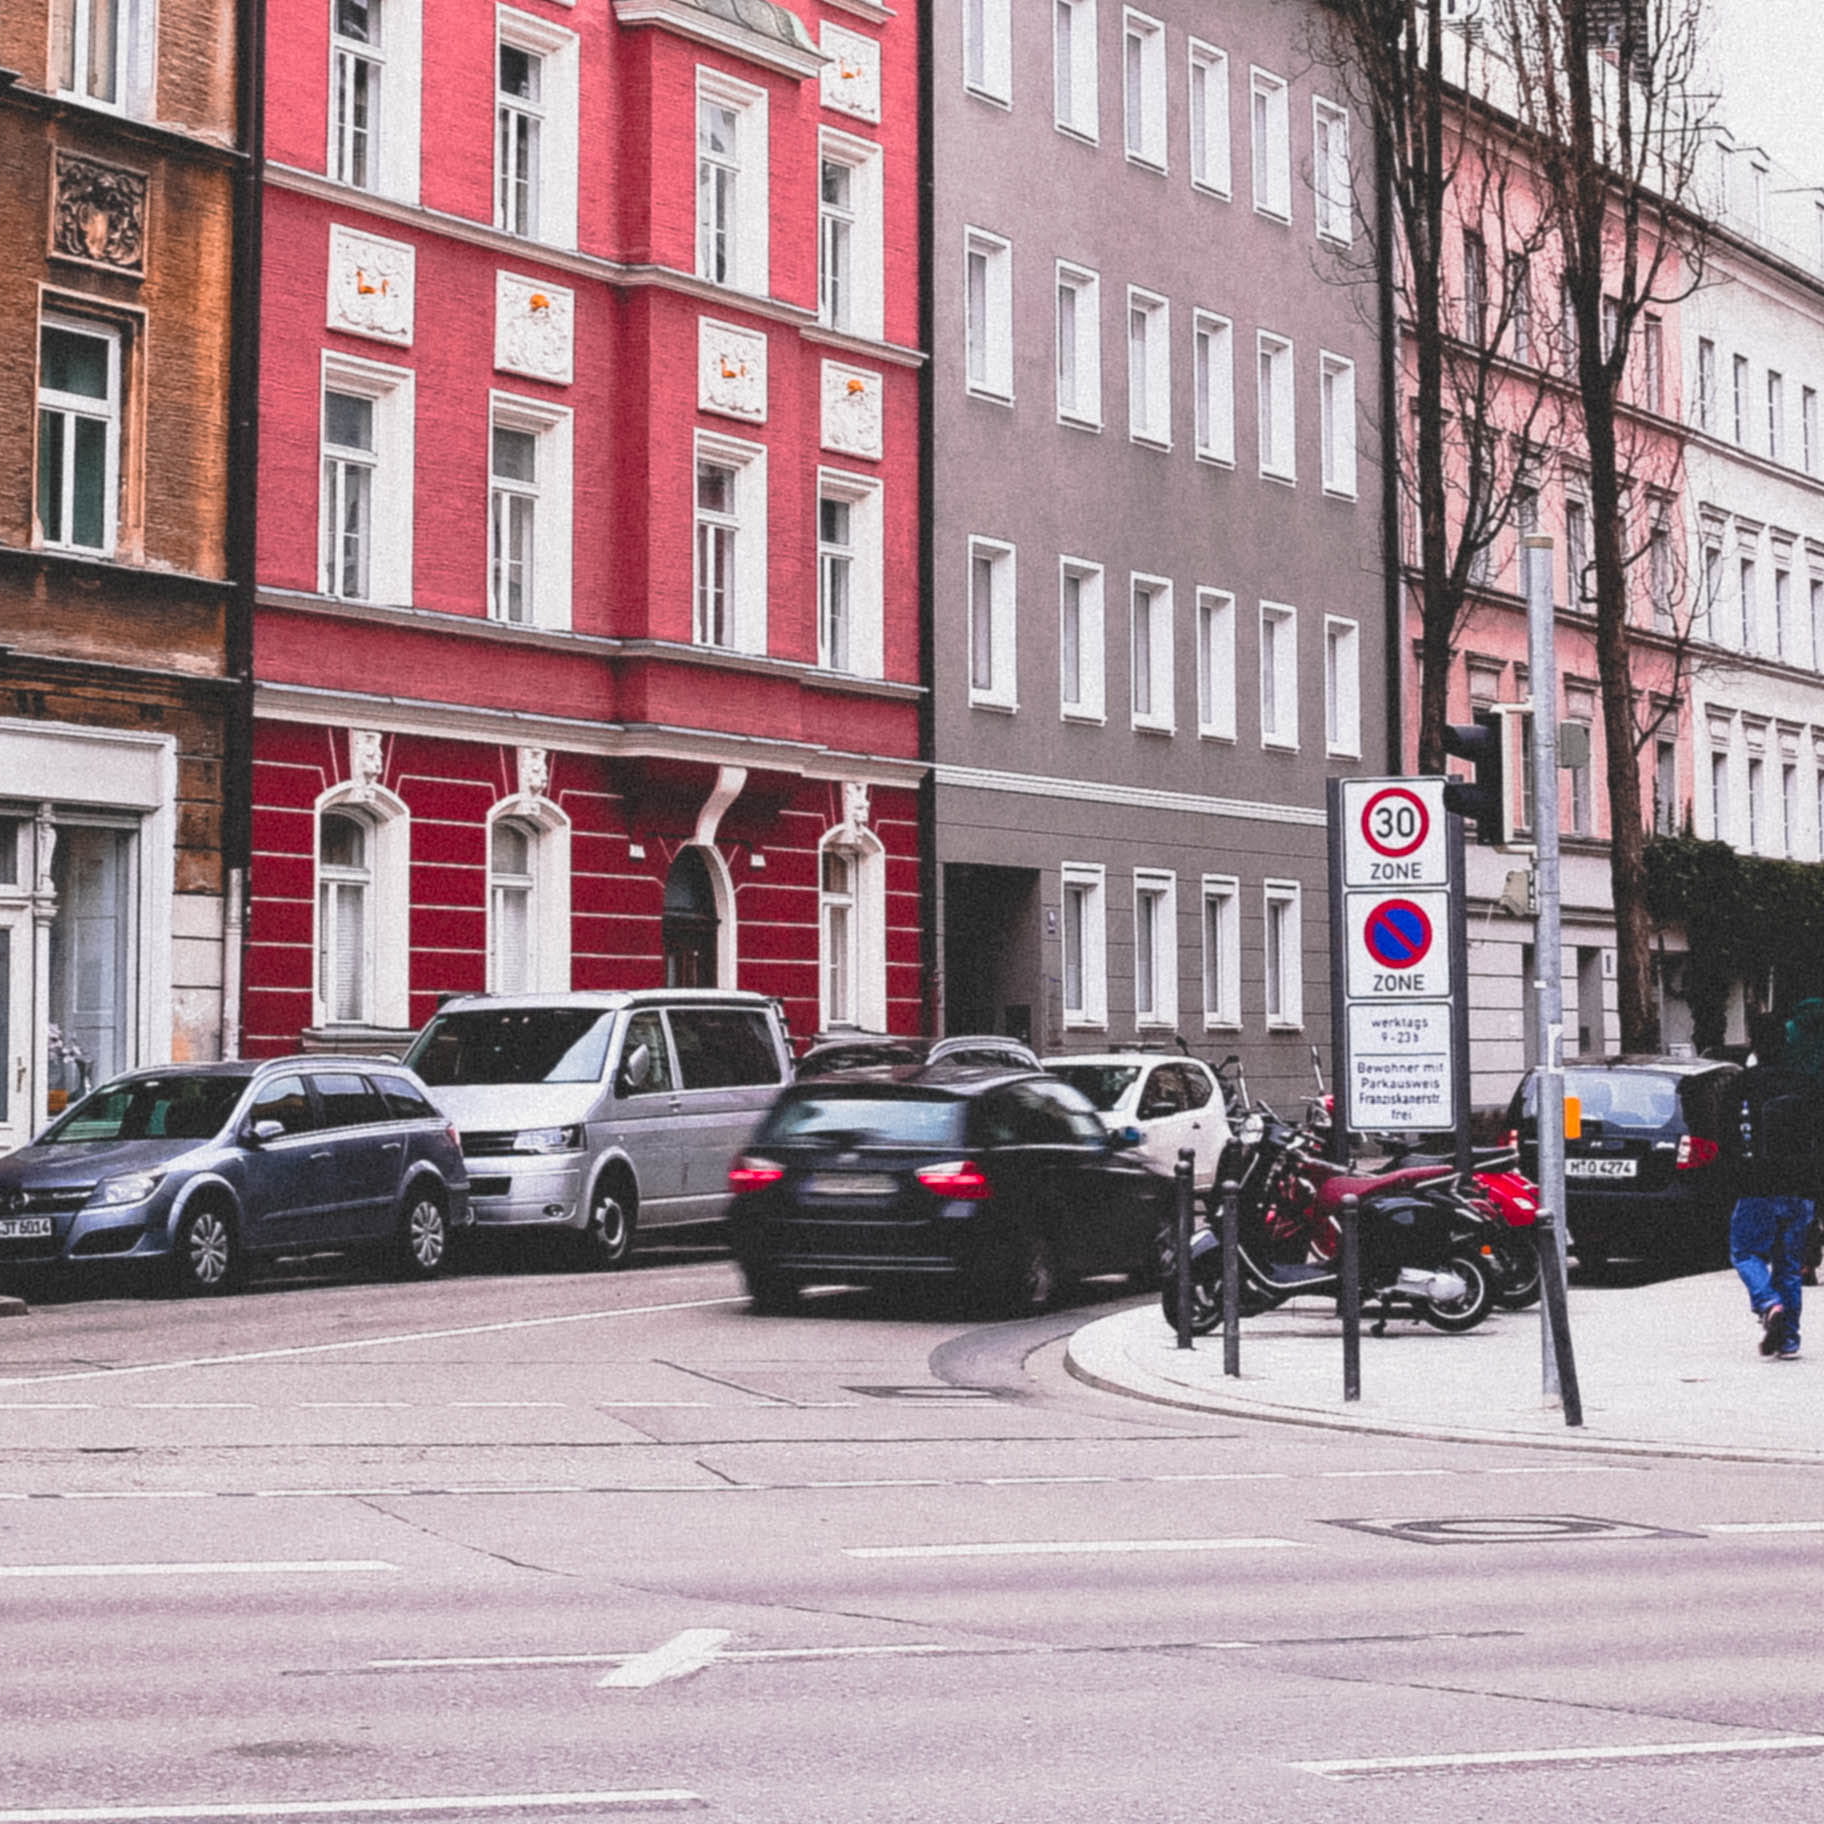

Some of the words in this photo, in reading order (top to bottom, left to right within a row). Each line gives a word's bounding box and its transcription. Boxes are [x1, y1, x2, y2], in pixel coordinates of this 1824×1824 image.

[1376, 807, 1415, 839] 30
[1370, 862, 1423, 880] ZONE
[1373, 974, 1425, 992] ZONE
[1371, 1017, 1429, 1031] werktags
[1357, 1062, 1420, 1074] Bewohner
[1423, 1063, 1444, 1073] mit
[1361, 1077, 1440, 1089] Parkausweis
[1391, 1108, 1413, 1120] frei
